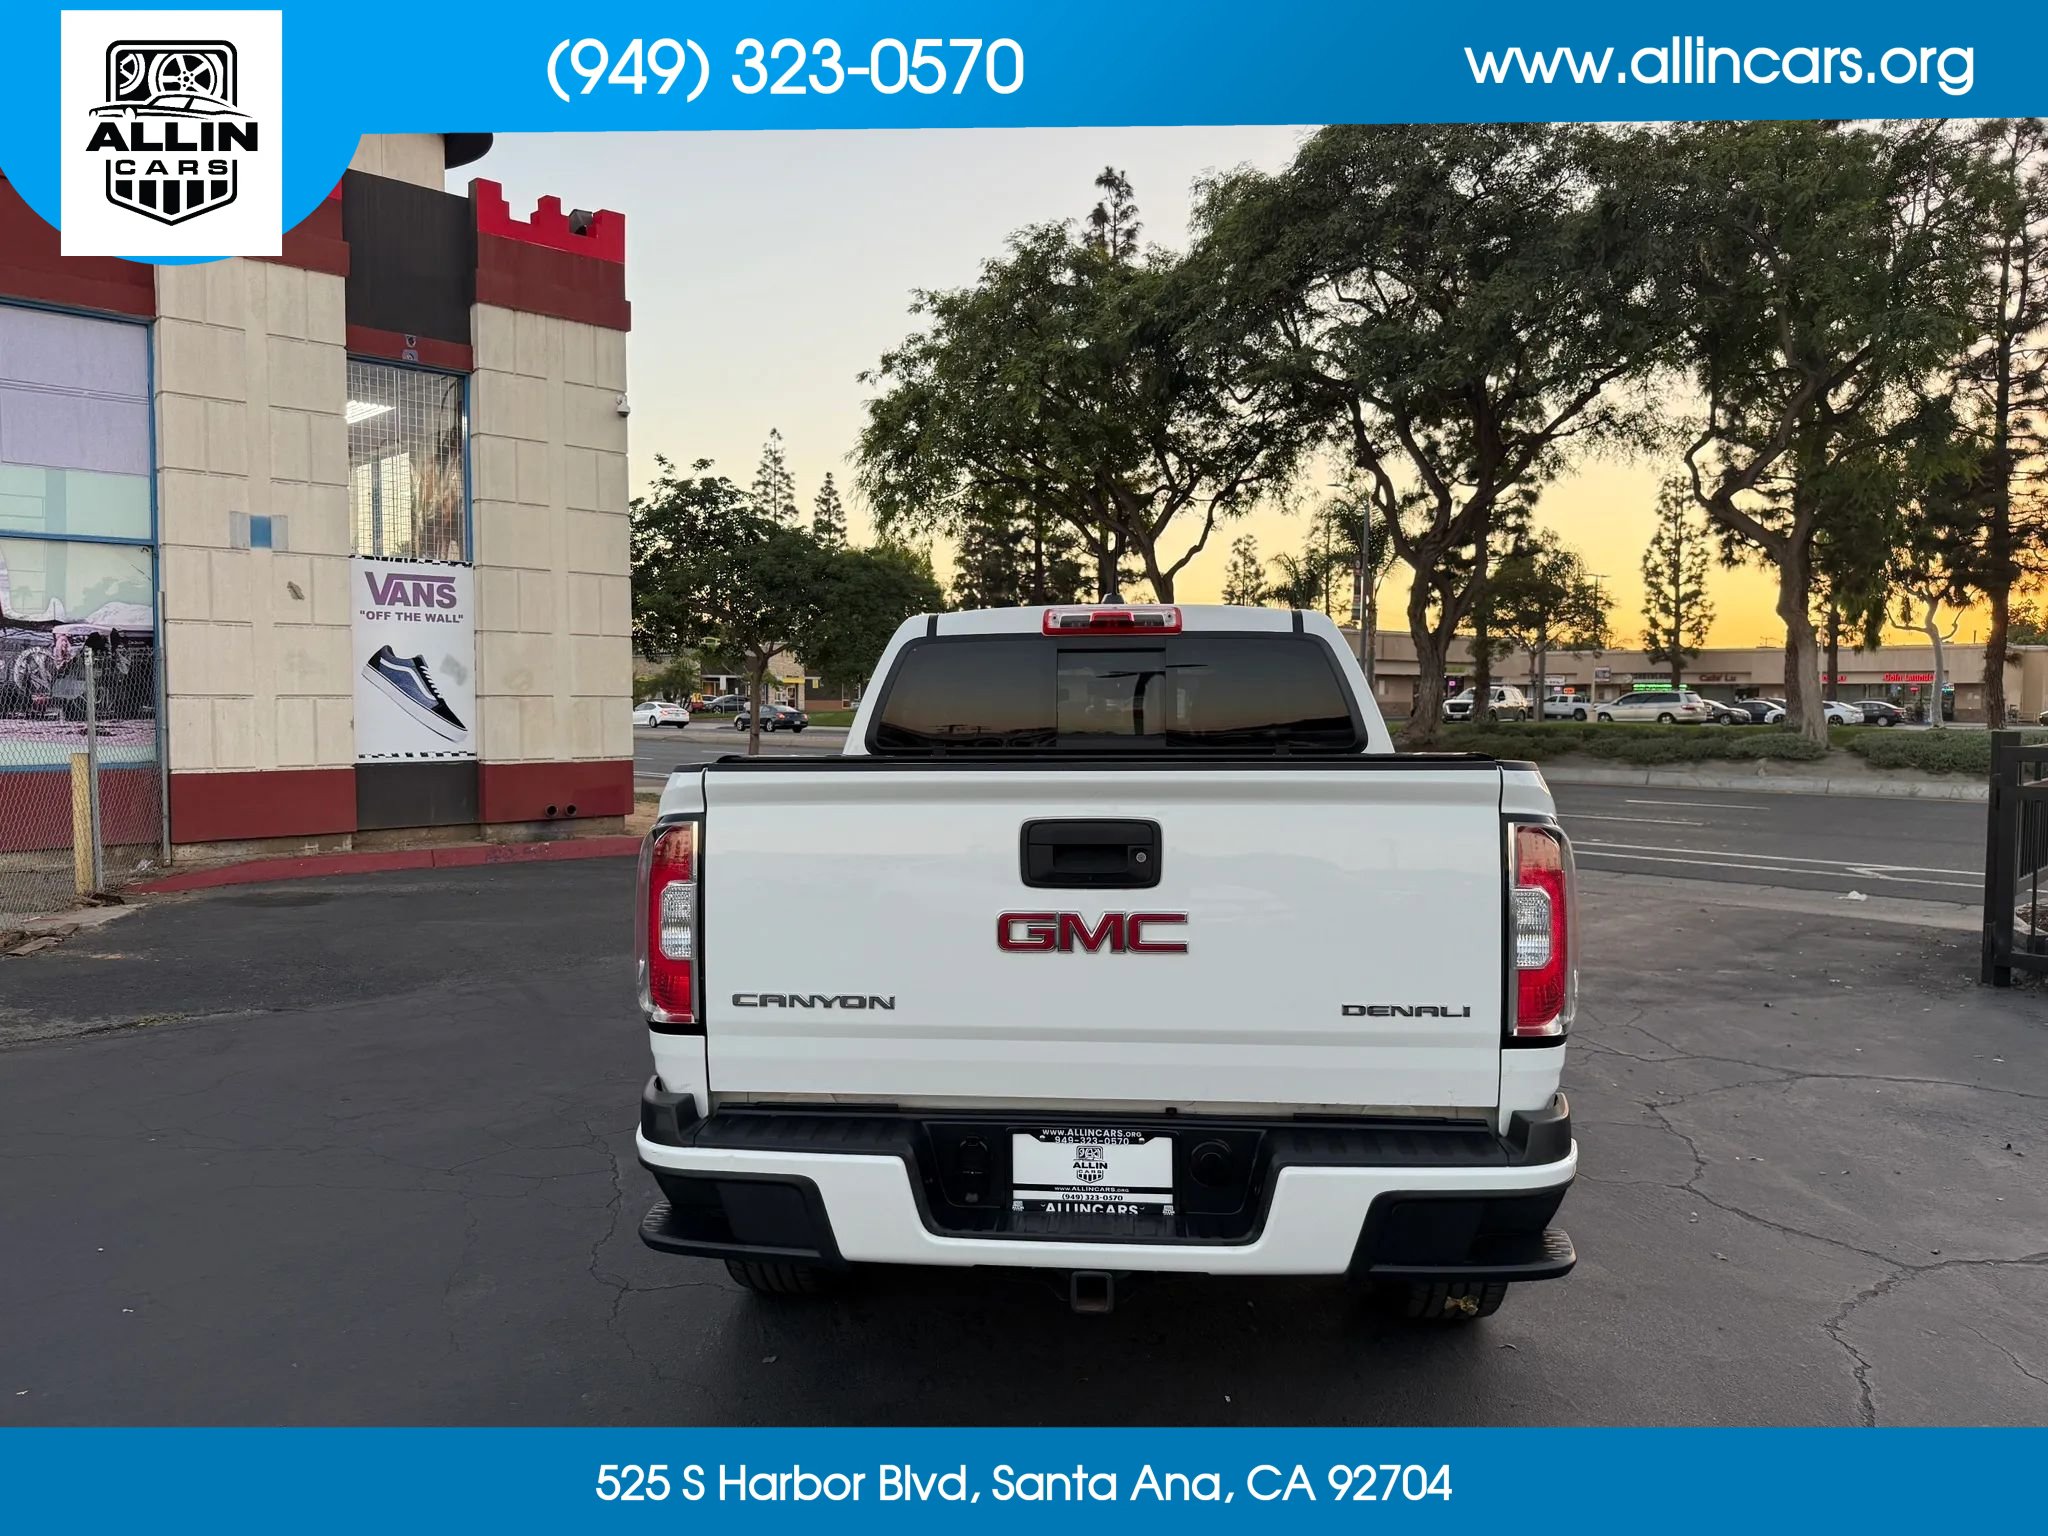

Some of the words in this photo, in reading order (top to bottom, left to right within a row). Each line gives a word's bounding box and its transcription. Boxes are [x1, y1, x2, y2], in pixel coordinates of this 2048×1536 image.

[364, 571, 457, 609] VANS
[395, 612, 421, 622] THE
[997, 909, 1190, 955] GMC
[732, 993, 896, 1010] CANYON
[1341, 1004, 1471, 1018] DENALI
[1054, 1136, 1130, 1145] 949-323-0570
[1073, 1161, 1108, 1170] ALLIN
[1062, 1193, 1083, 1201] (949)
